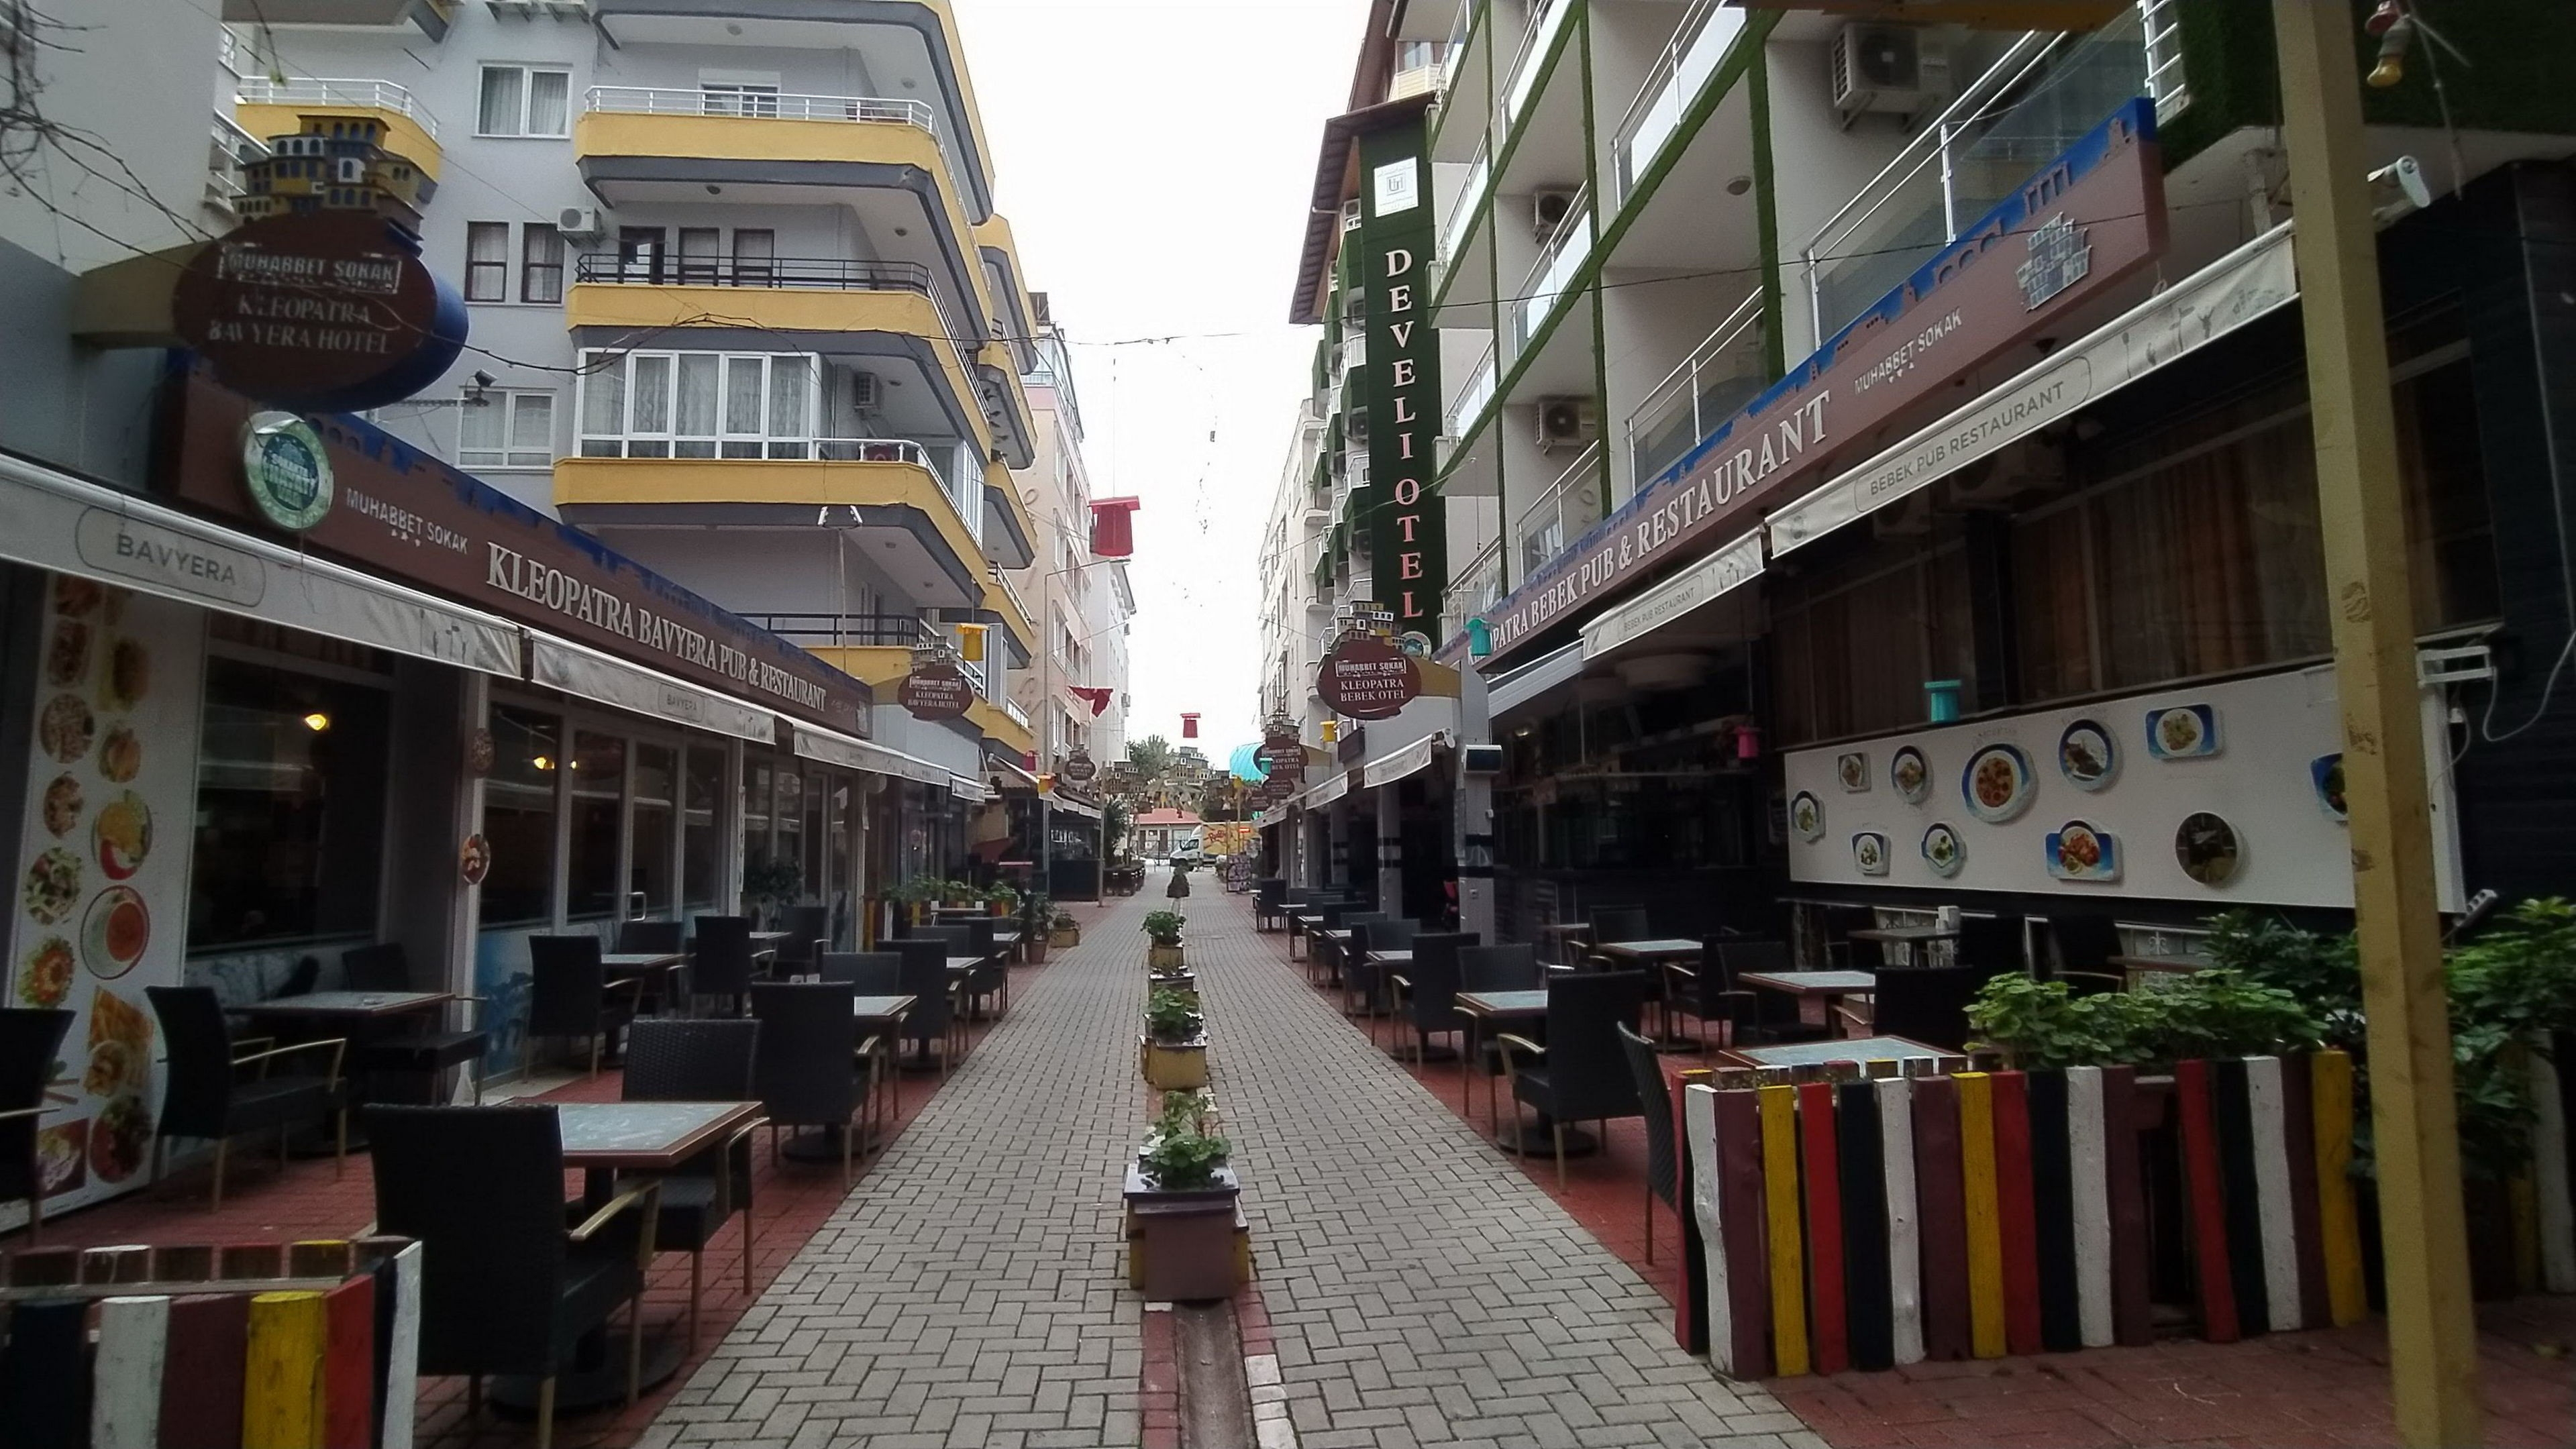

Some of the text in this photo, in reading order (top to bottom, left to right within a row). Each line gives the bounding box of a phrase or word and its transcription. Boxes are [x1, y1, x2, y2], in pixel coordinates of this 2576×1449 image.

[228, 252, 395, 281] MUHABBET SOKAK
[317, 329, 392, 354] HOTEL
[1854, 307, 1963, 394] MUHABBET SOKAK
[1870, 380, 2065, 497] BEBEK PUB RESTAURANT
[346, 487, 423, 537] MUHABBET
[427, 521, 468, 555] SOKAK
[1394, 478, 1423, 619] OTEL
[1467, 390, 1831, 665] KPATRA BEBEK PUB & RESTAURANT
[116, 533, 237, 586] BAVYERA
[486, 541, 827, 712] KLEOPATRA BAVYERA PUB & RESTAURANT
[1341, 678, 1404, 690] KLEOPATRA
[1379, 661, 1403, 670] SOKAK
[1340, 690, 1406, 702] BEBEK OTEL
